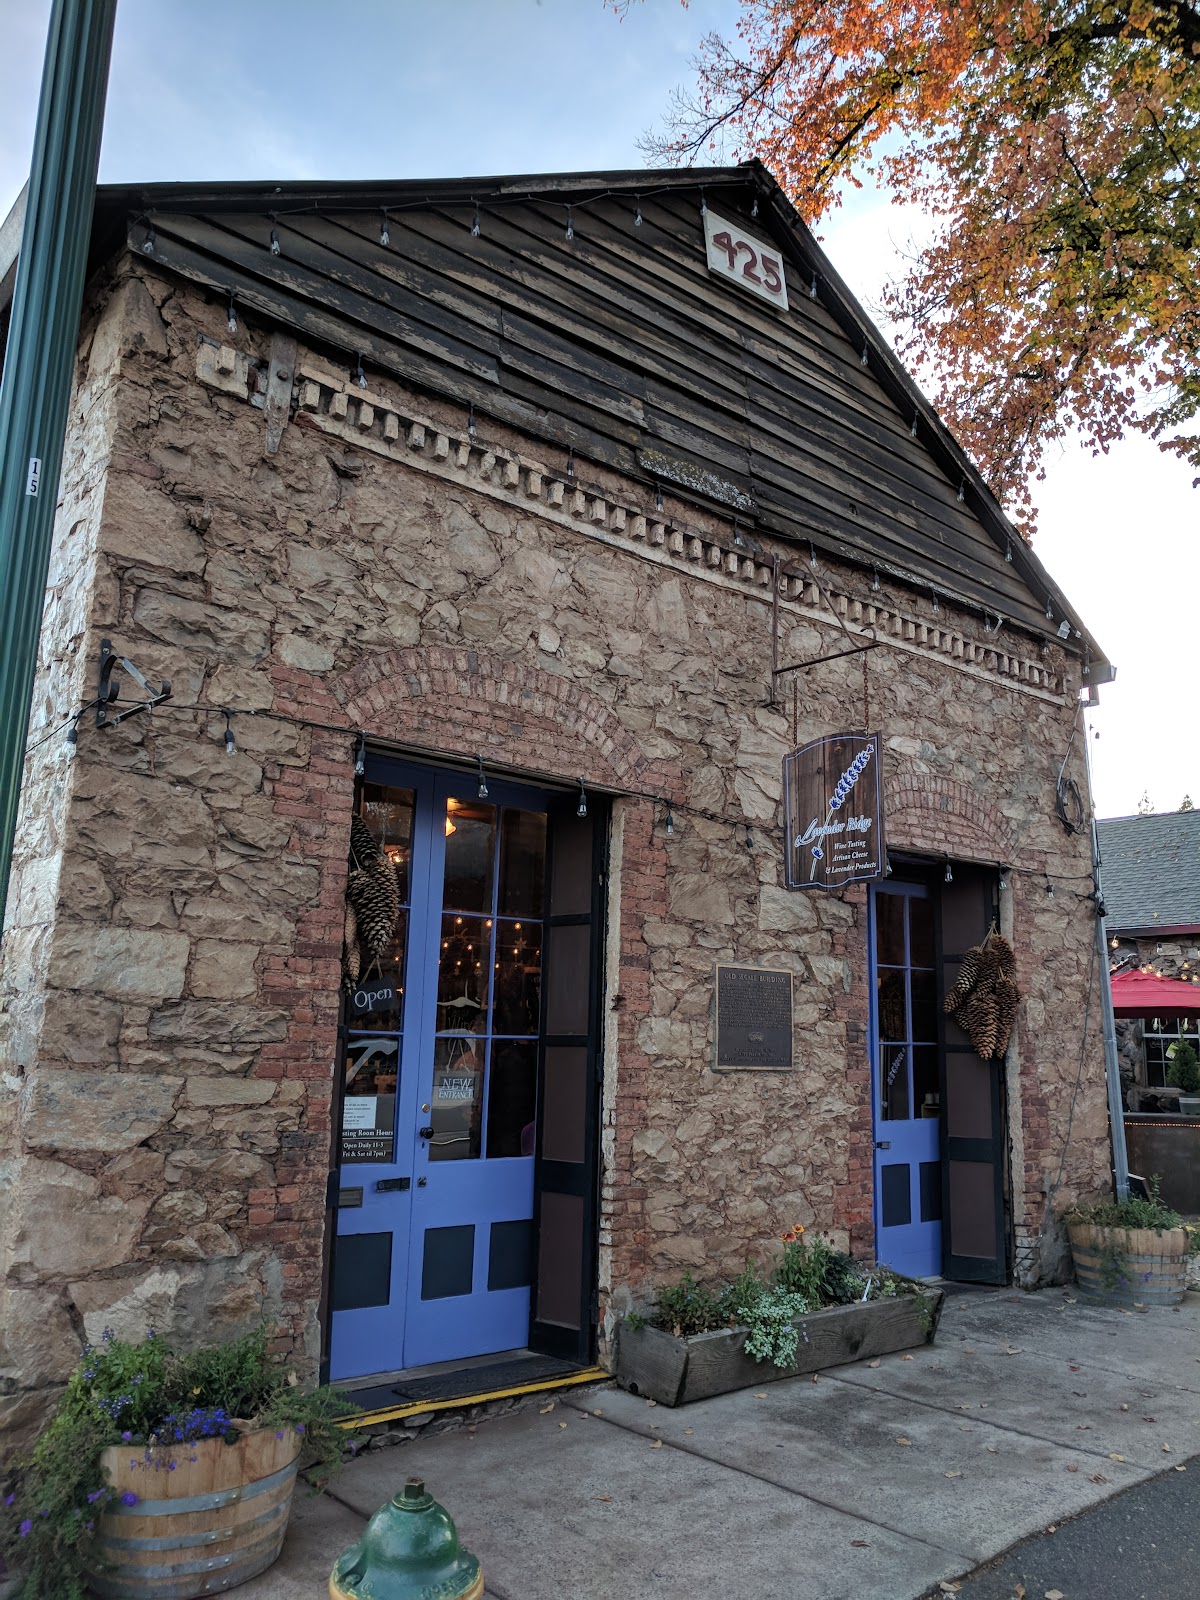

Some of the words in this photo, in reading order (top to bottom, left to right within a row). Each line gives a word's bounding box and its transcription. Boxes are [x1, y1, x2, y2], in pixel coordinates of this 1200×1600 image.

[712, 231, 782, 294] 425
[794, 818, 845, 847] Lavender
[846, 815, 873, 833] Ridge
[834, 842, 847, 850] Wine
[847, 839, 867, 848] Tasting
[832, 854, 851, 862] Artisan
[851, 851, 869, 859] Cheese
[831, 864, 855, 874] Lavender
[855, 861, 877, 870] Products
[724, 972, 737, 980] OLD
[759, 975, 786, 984] BUILDING
[354, 988, 393, 1012] Open
[442, 1078, 473, 1091] NEW
[343, 1142, 357, 1150] Open
[358, 1142, 372, 1150] Daily
